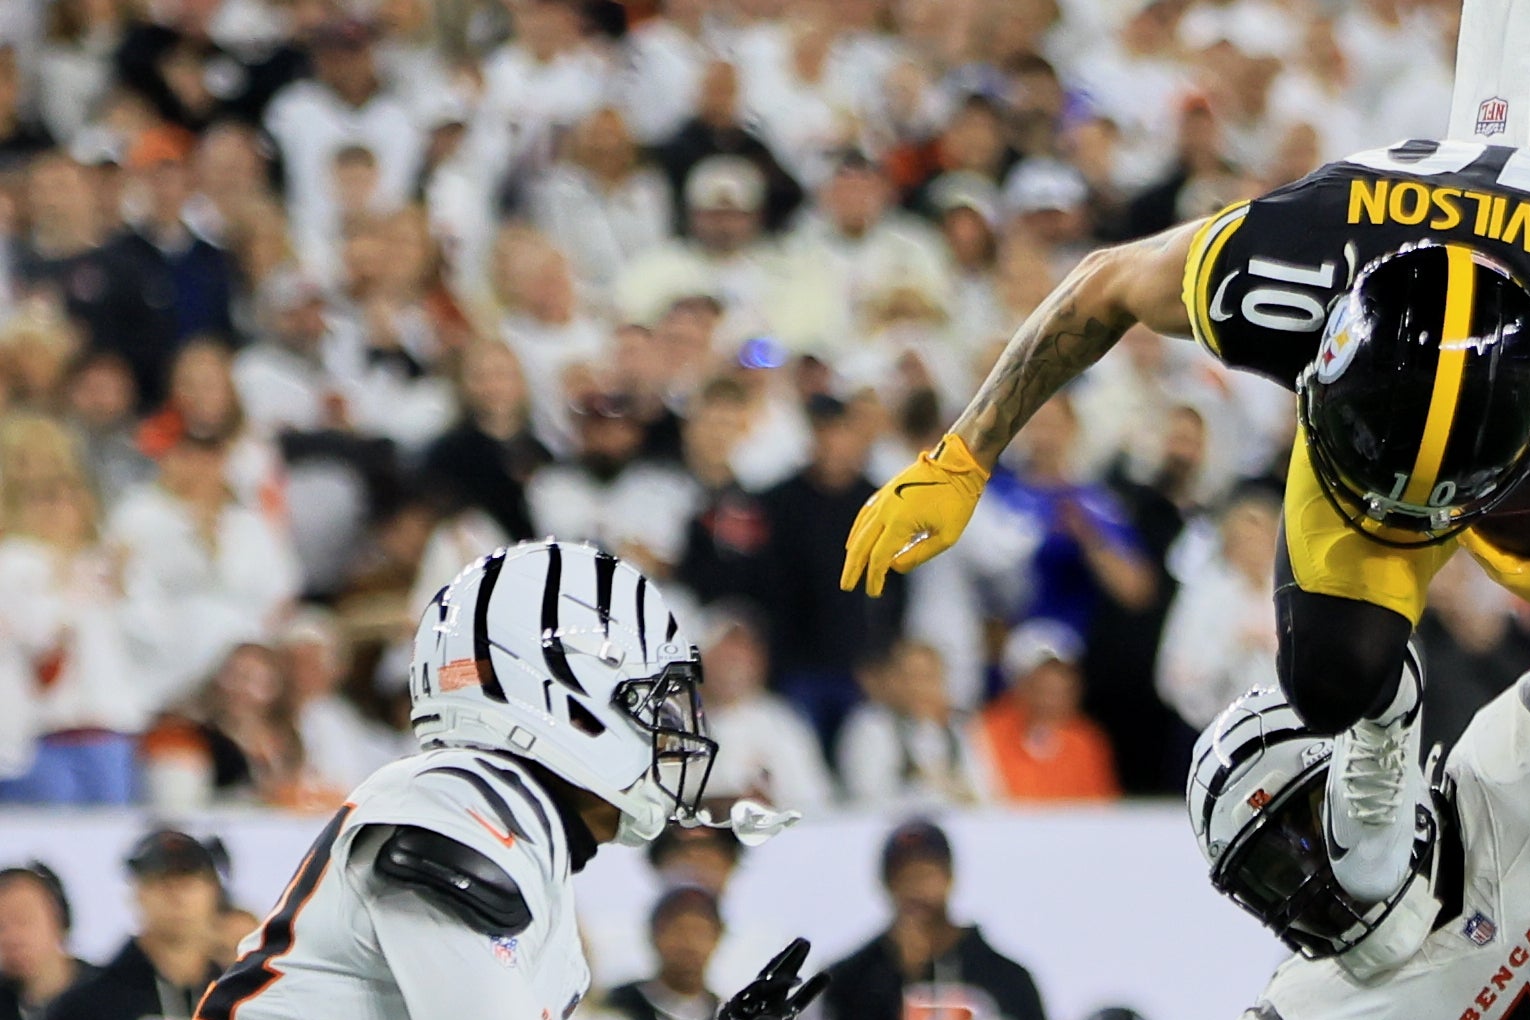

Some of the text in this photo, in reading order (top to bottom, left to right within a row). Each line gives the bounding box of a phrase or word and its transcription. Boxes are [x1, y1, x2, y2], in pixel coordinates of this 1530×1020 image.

[1481, 101, 1506, 121] NFL
[1241, 259, 1335, 332] 10
[1388, 472, 1457, 507] 10
